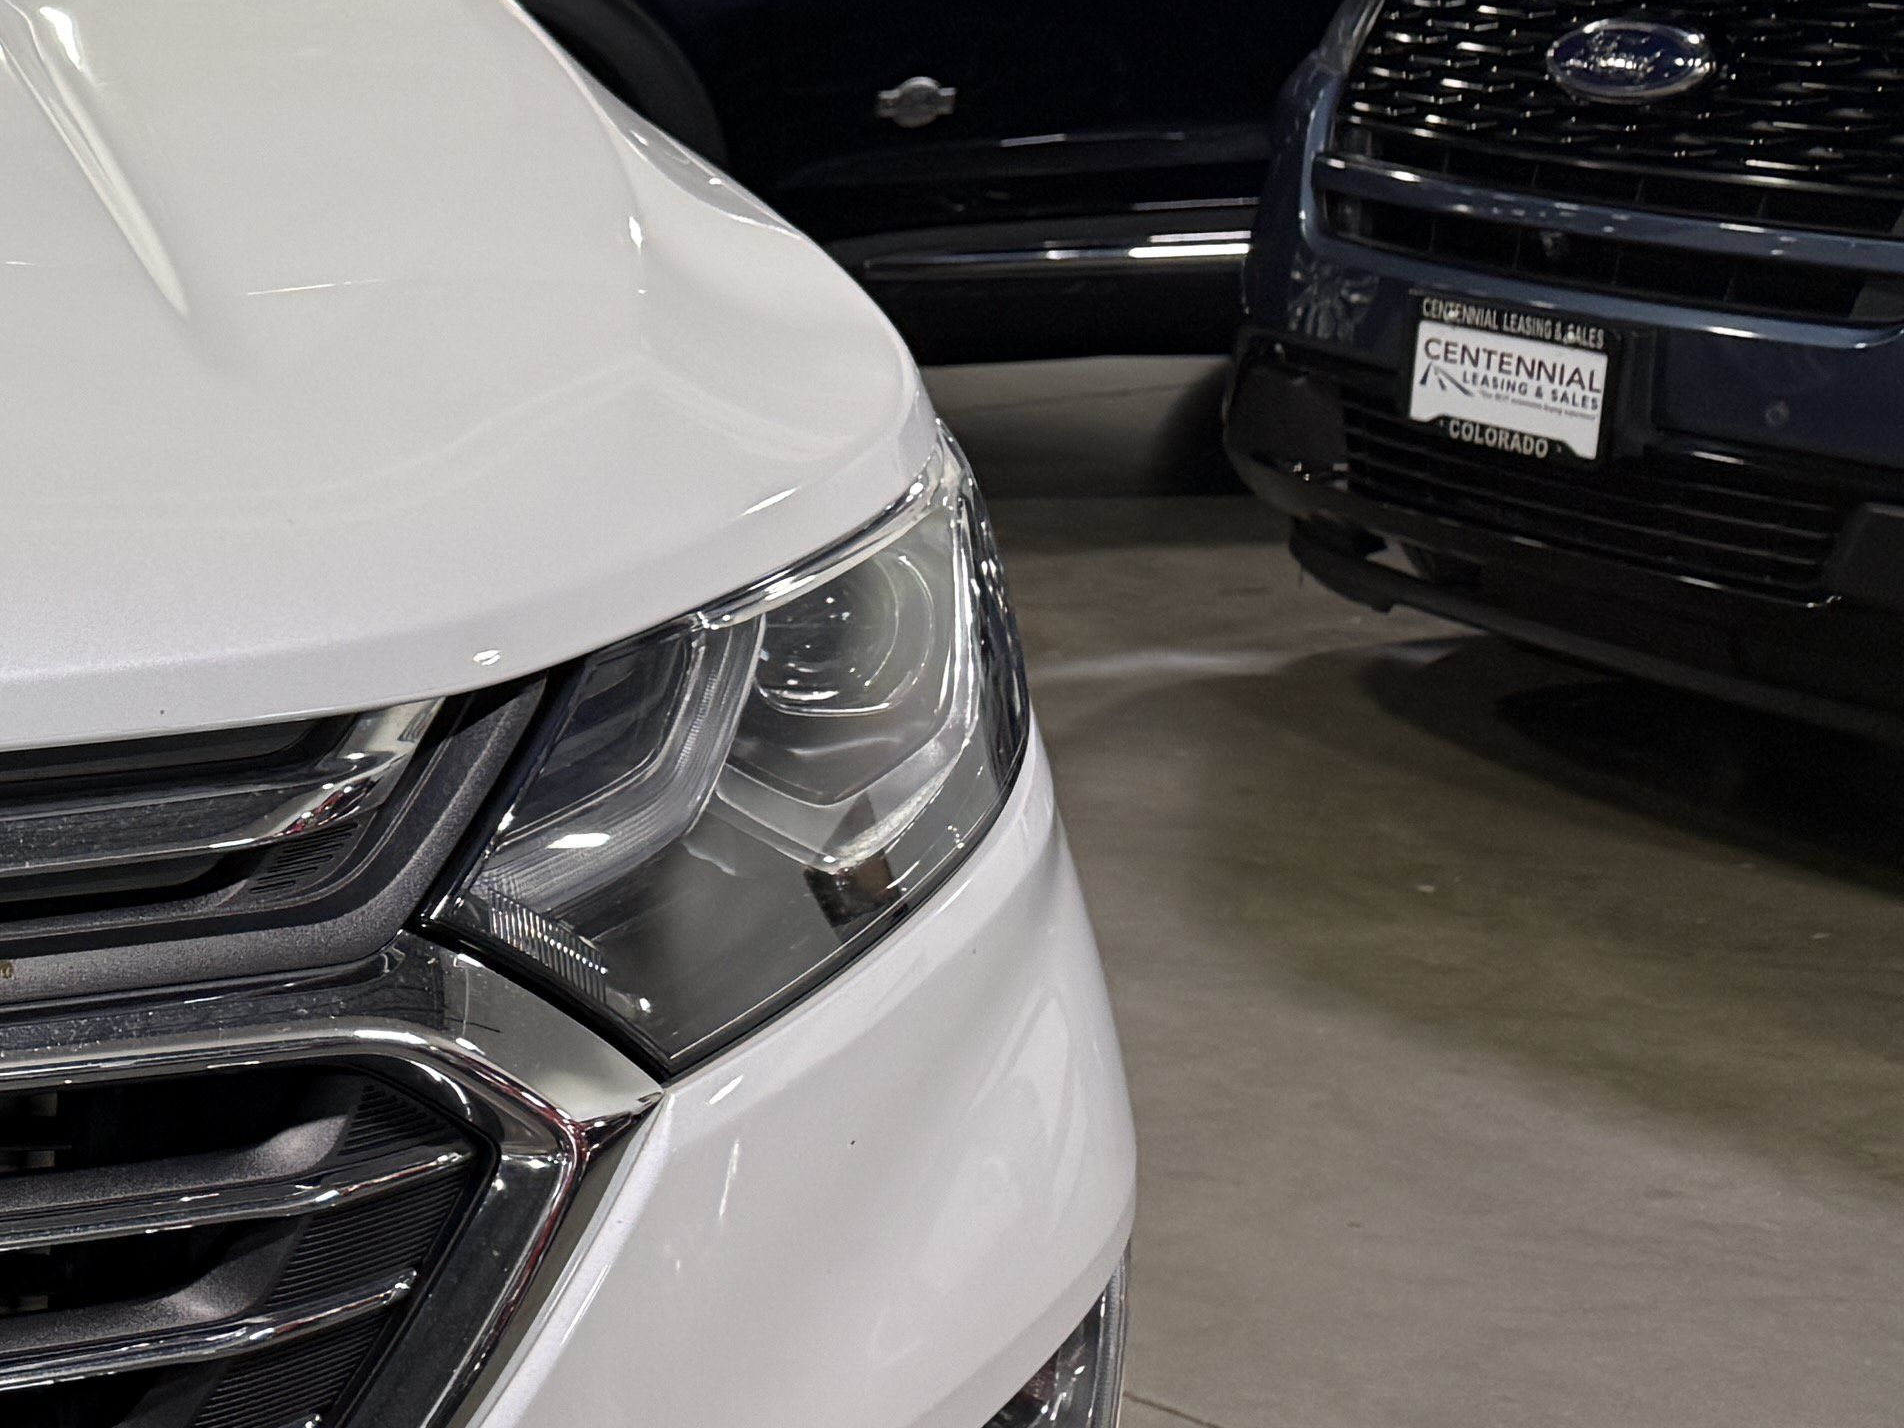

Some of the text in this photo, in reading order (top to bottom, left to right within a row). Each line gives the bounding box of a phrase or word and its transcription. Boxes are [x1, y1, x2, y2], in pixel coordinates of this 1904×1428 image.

[1503, 312, 1552, 340] LEASING
[1424, 337, 1601, 393] CENTENNIAL
[1462, 370, 1528, 396] LEASING
[1551, 388, 1598, 411] SALES
[1449, 420, 1549, 459] COLORADO
